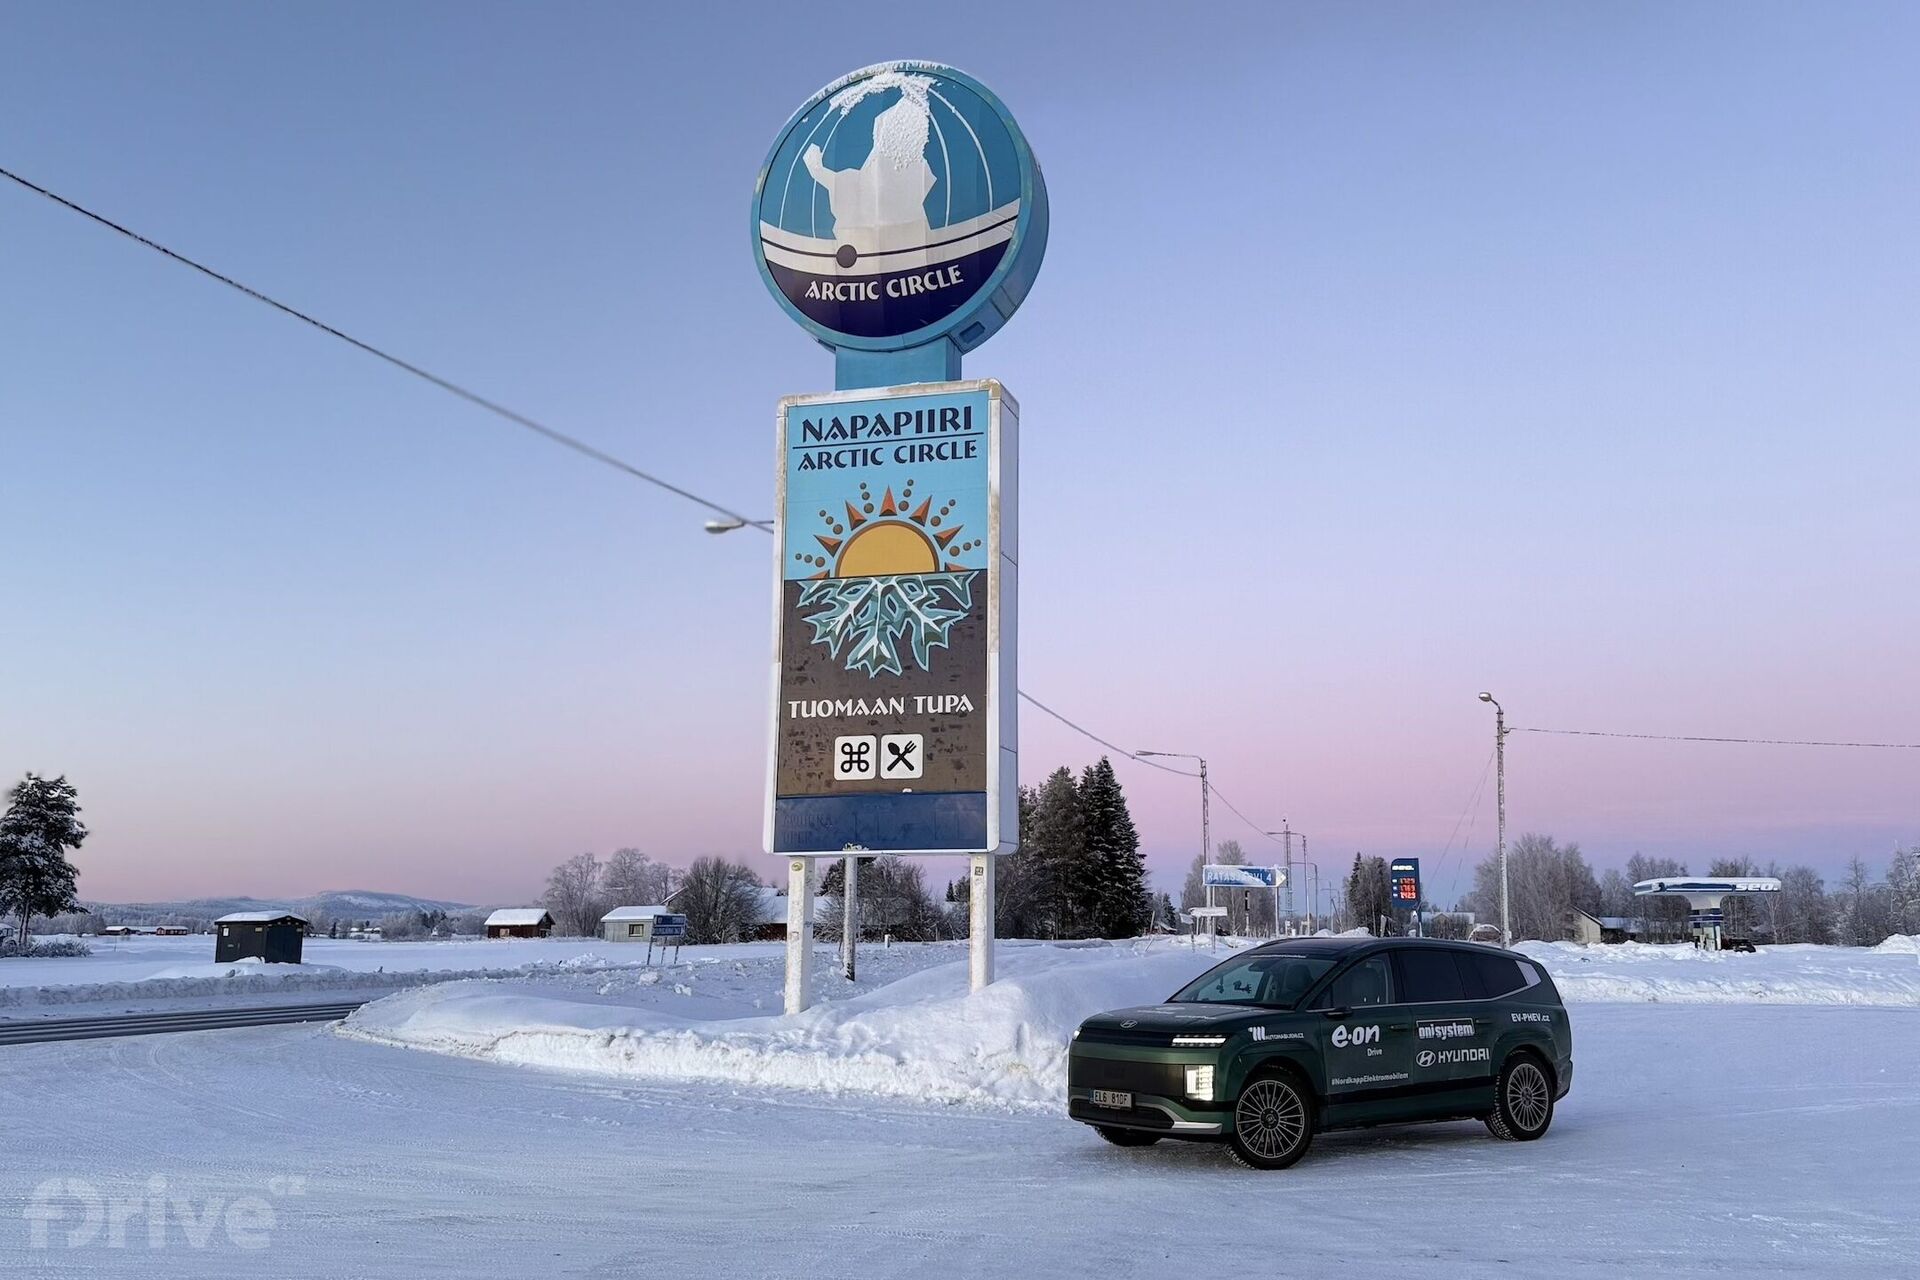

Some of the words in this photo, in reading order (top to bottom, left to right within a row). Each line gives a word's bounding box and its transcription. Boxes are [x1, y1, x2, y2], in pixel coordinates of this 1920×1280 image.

[804, 280, 880, 301] ARCTIC
[886, 264, 964, 298] CIRCLE
[802, 405, 972, 443] NAPAPIIRI
[797, 447, 884, 471] ARCTIC
[894, 439, 978, 464] CIRCLE
[788, 696, 905, 719] TUOMAAN
[913, 694, 975, 714] TUPA
[1266, 873, 1272, 882] 4
[1511, 1013, 1551, 1022] EV-PHEV.cz
[1366, 1048, 1383, 1057] Drive
[1438, 1047, 1490, 1064] HYUNDAI
